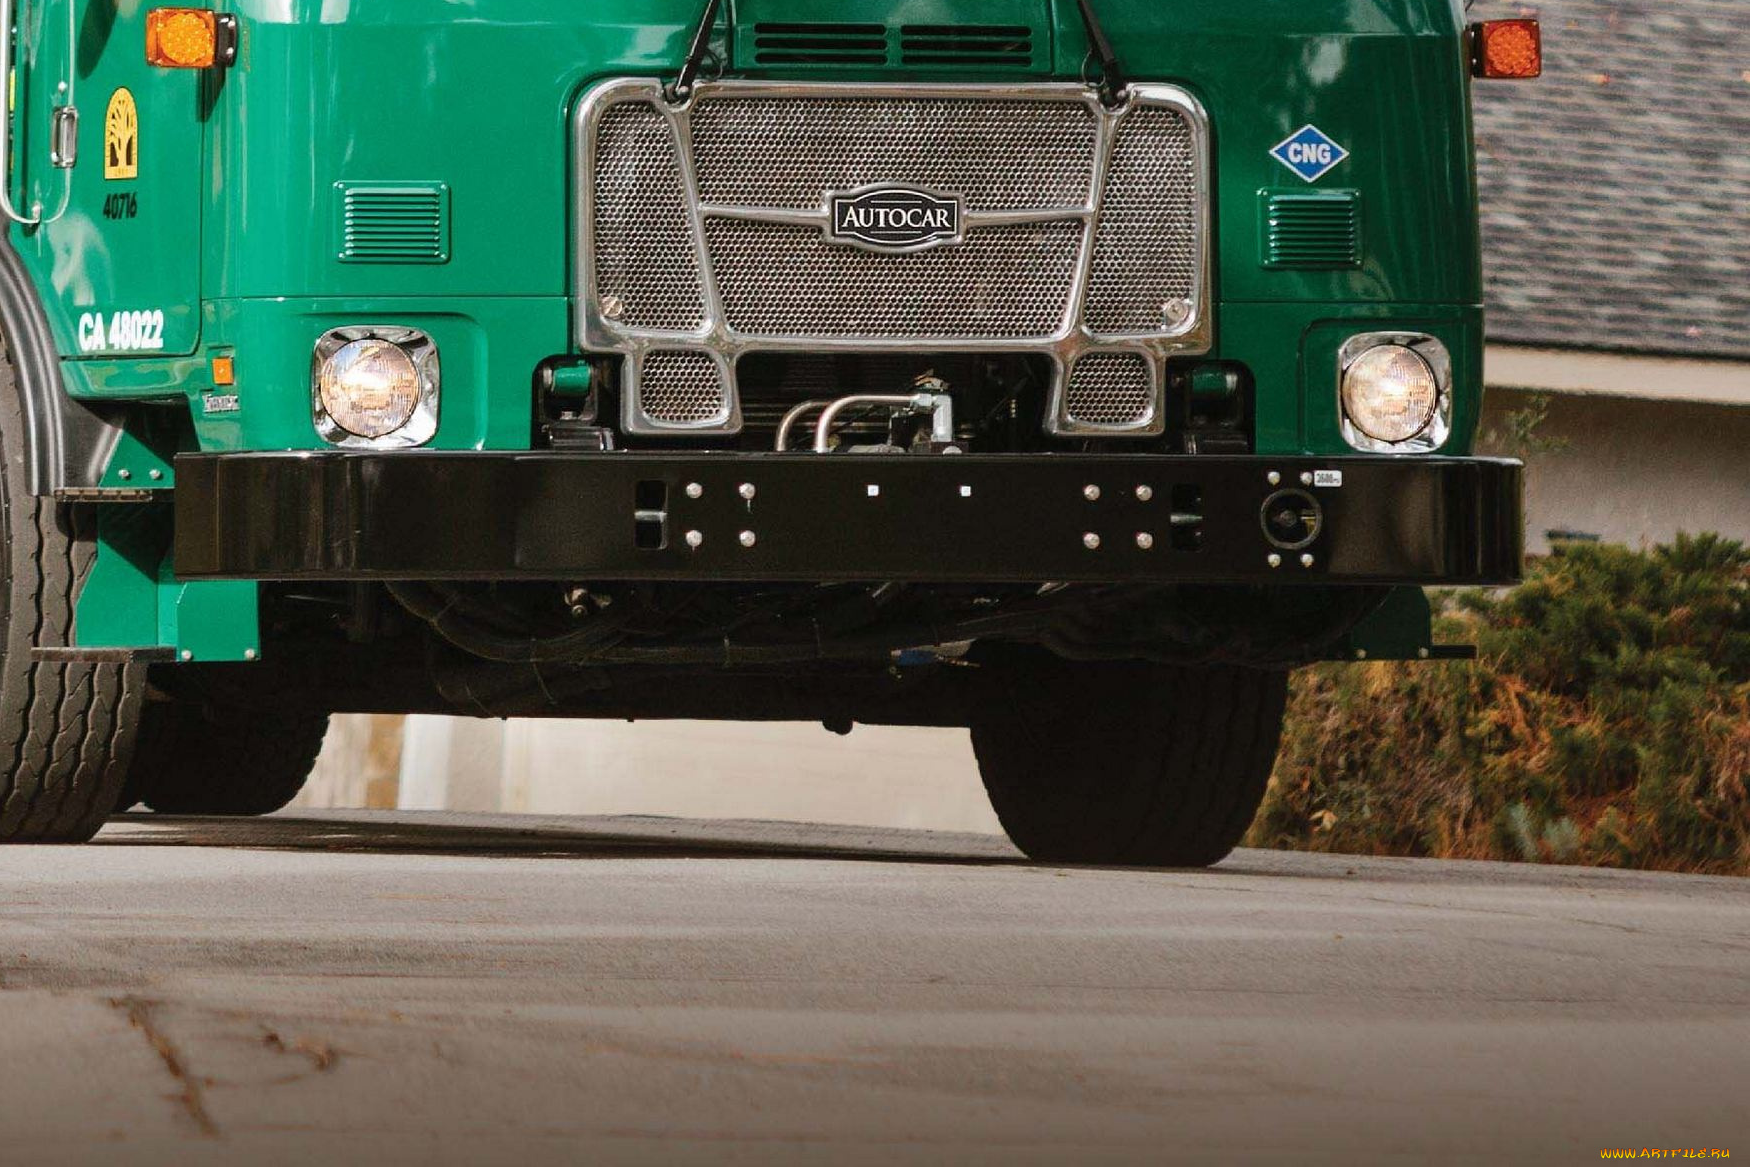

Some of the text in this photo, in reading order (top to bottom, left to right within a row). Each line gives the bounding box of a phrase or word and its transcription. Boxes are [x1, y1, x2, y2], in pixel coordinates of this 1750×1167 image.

[1288, 142, 1331, 164] CNG
[103, 192, 138, 219] 40716
[841, 206, 952, 228] AUTOCAR
[78, 309, 164, 351] CA 48022
